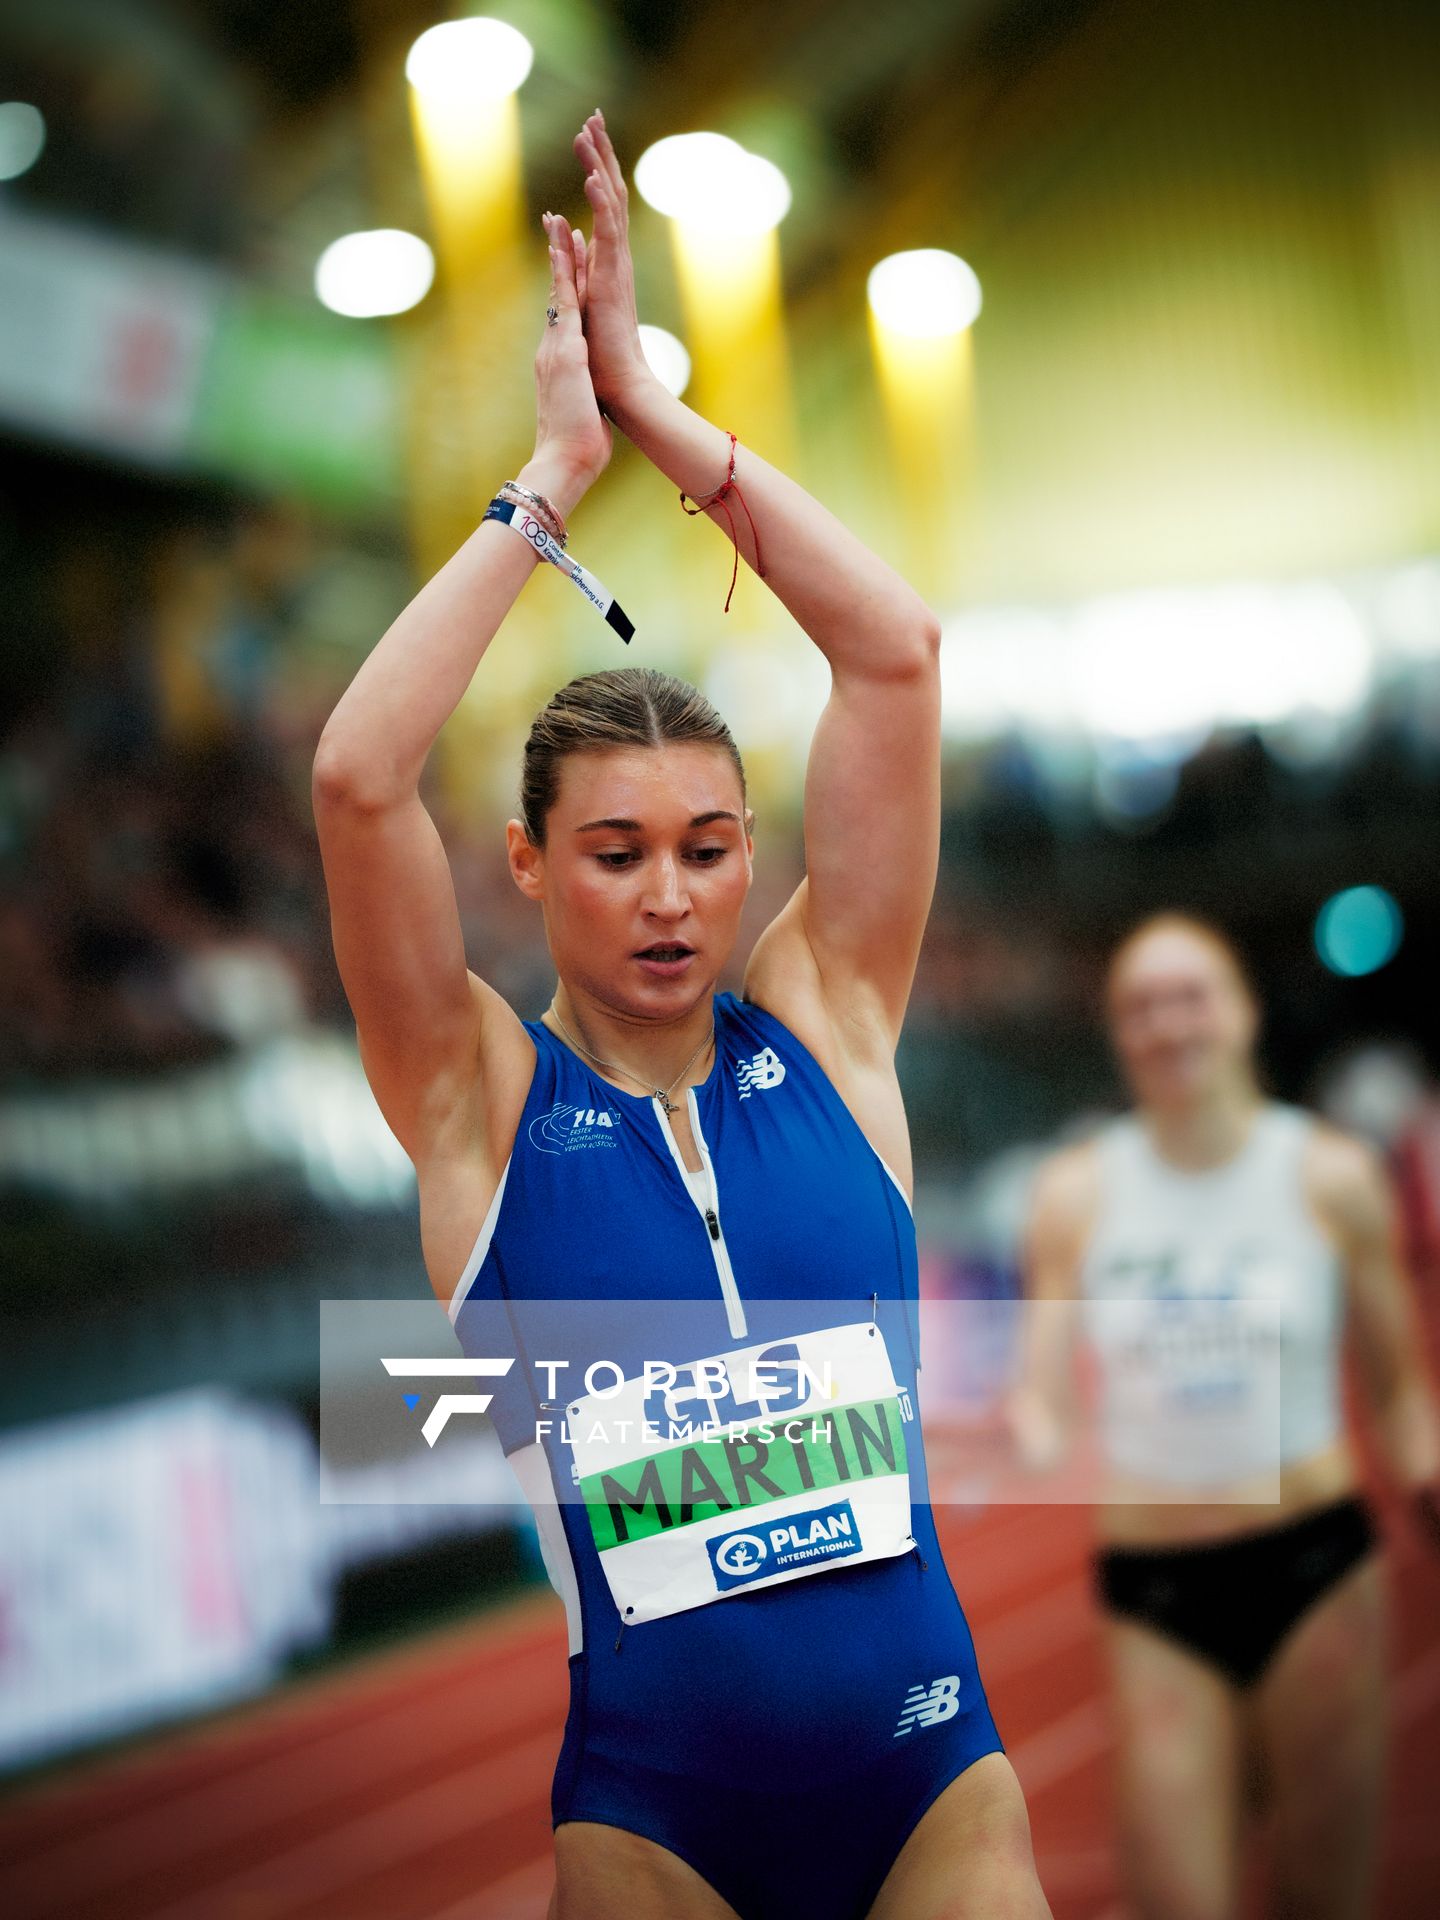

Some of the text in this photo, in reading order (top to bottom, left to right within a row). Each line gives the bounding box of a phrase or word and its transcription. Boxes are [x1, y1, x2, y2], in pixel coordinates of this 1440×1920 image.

[520, 516, 547, 547] 100
[569, 571, 596, 601] sicherung
[601, 1402, 898, 1543] MARTIN
[769, 1512, 852, 1553] PLAN
[776, 1539, 856, 1565] INTERNATIONAL
